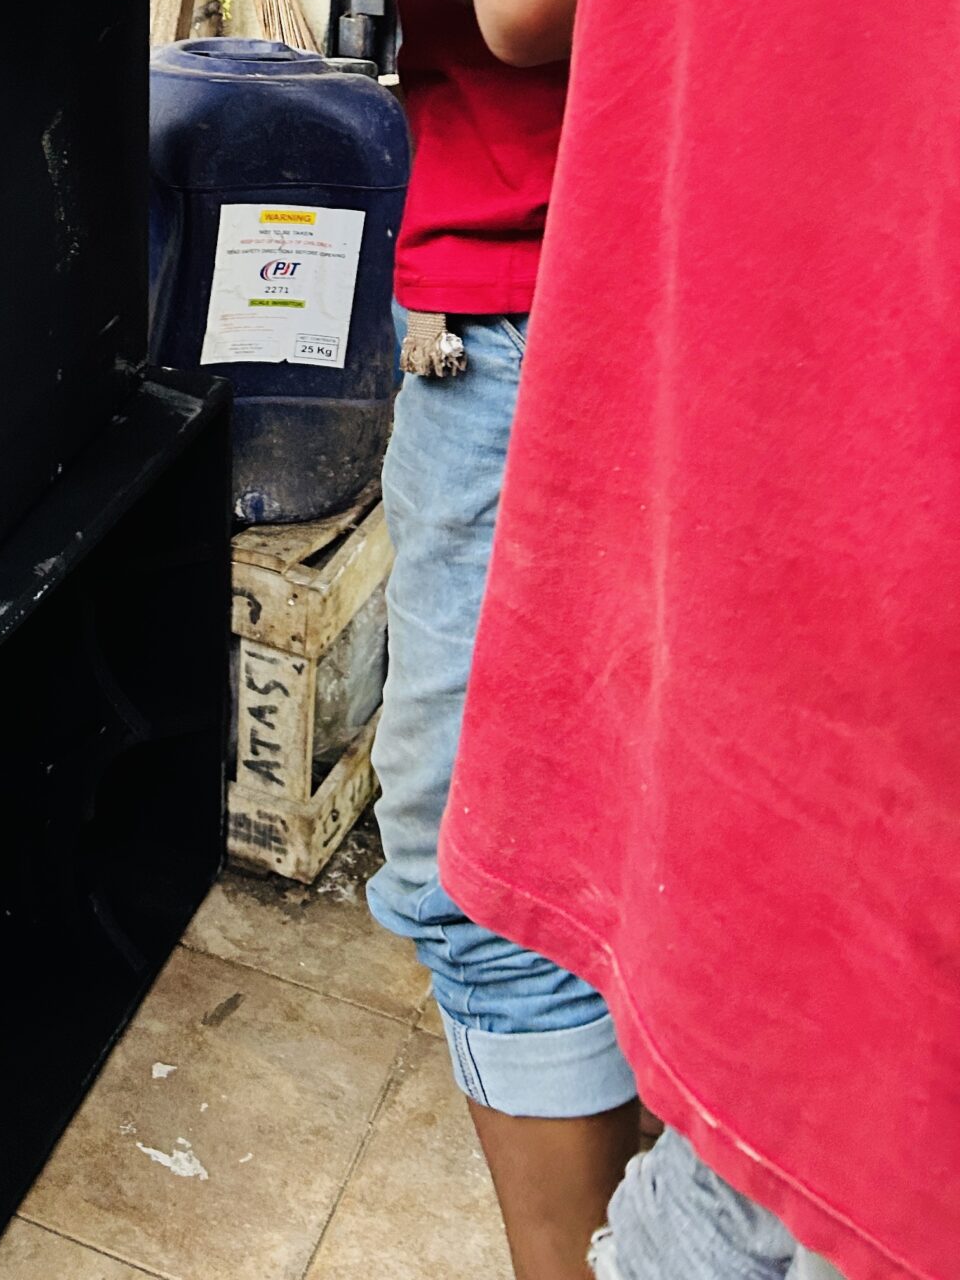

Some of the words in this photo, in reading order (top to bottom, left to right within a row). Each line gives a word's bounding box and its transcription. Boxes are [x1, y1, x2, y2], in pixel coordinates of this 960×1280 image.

[265, 212, 311, 223] WARNING
[272, 261, 302, 276] PJT
[264, 286, 289, 294] 2271
[301, 344, 314, 353] 25
[316, 345, 333, 358] Kg
